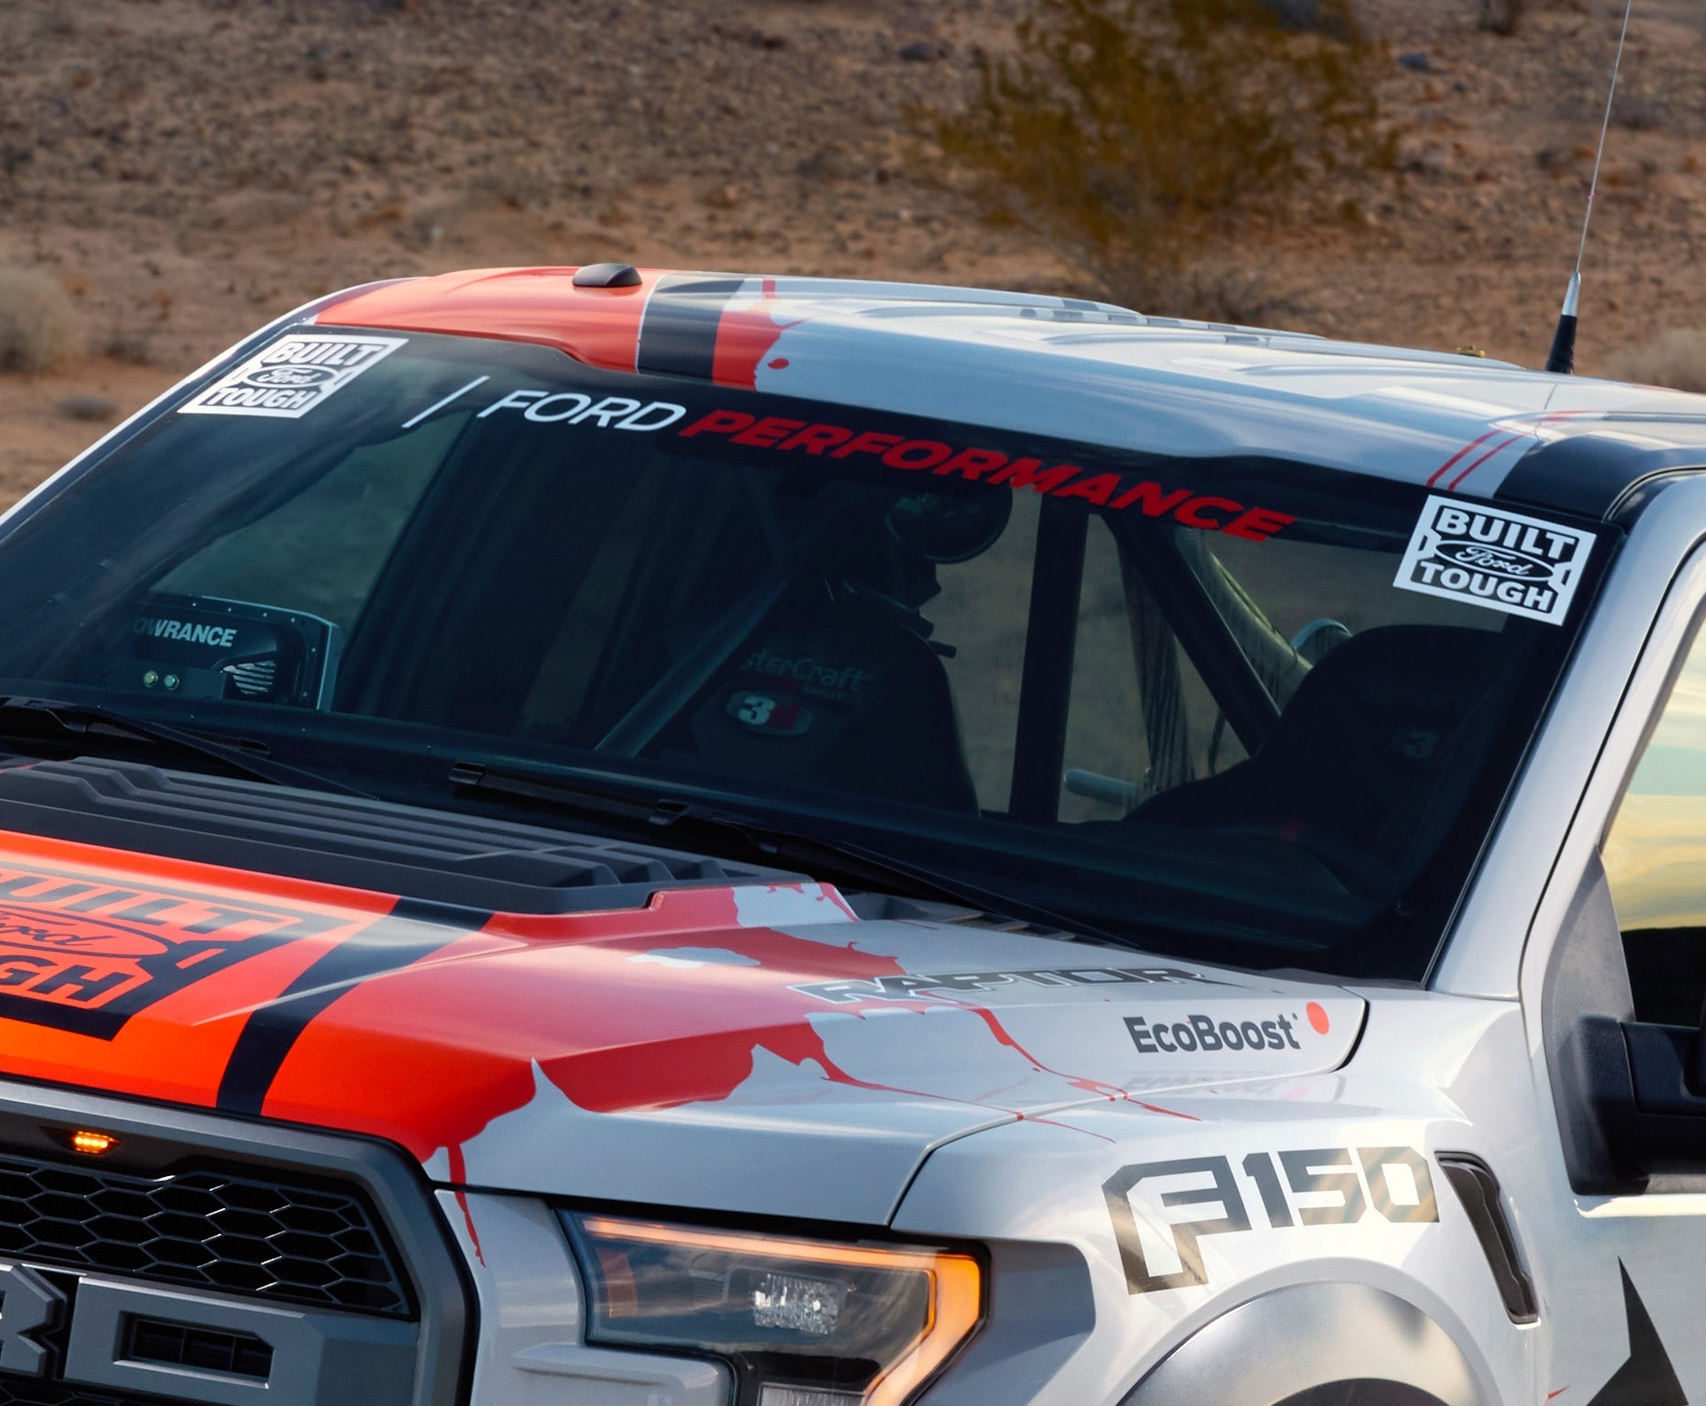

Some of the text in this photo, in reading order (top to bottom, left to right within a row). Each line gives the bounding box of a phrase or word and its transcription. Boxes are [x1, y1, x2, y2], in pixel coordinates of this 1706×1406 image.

[262, 342, 384, 366] BUILT
[256, 366, 321, 384] Ford
[206, 387, 317, 410] TOUGH
[476, 389, 1299, 542] FORD PERFORMANCE
[1435, 507, 1576, 560] BUILT
[1455, 546, 1535, 576] Ford
[1419, 560, 1554, 612] TOUGH
[132, 617, 238, 648] OWRANCE
[786, 966, 1278, 1004] RAPTOR
[1122, 1011, 1302, 1055] EcoBoost
[1100, 1146, 1440, 1296] F150
